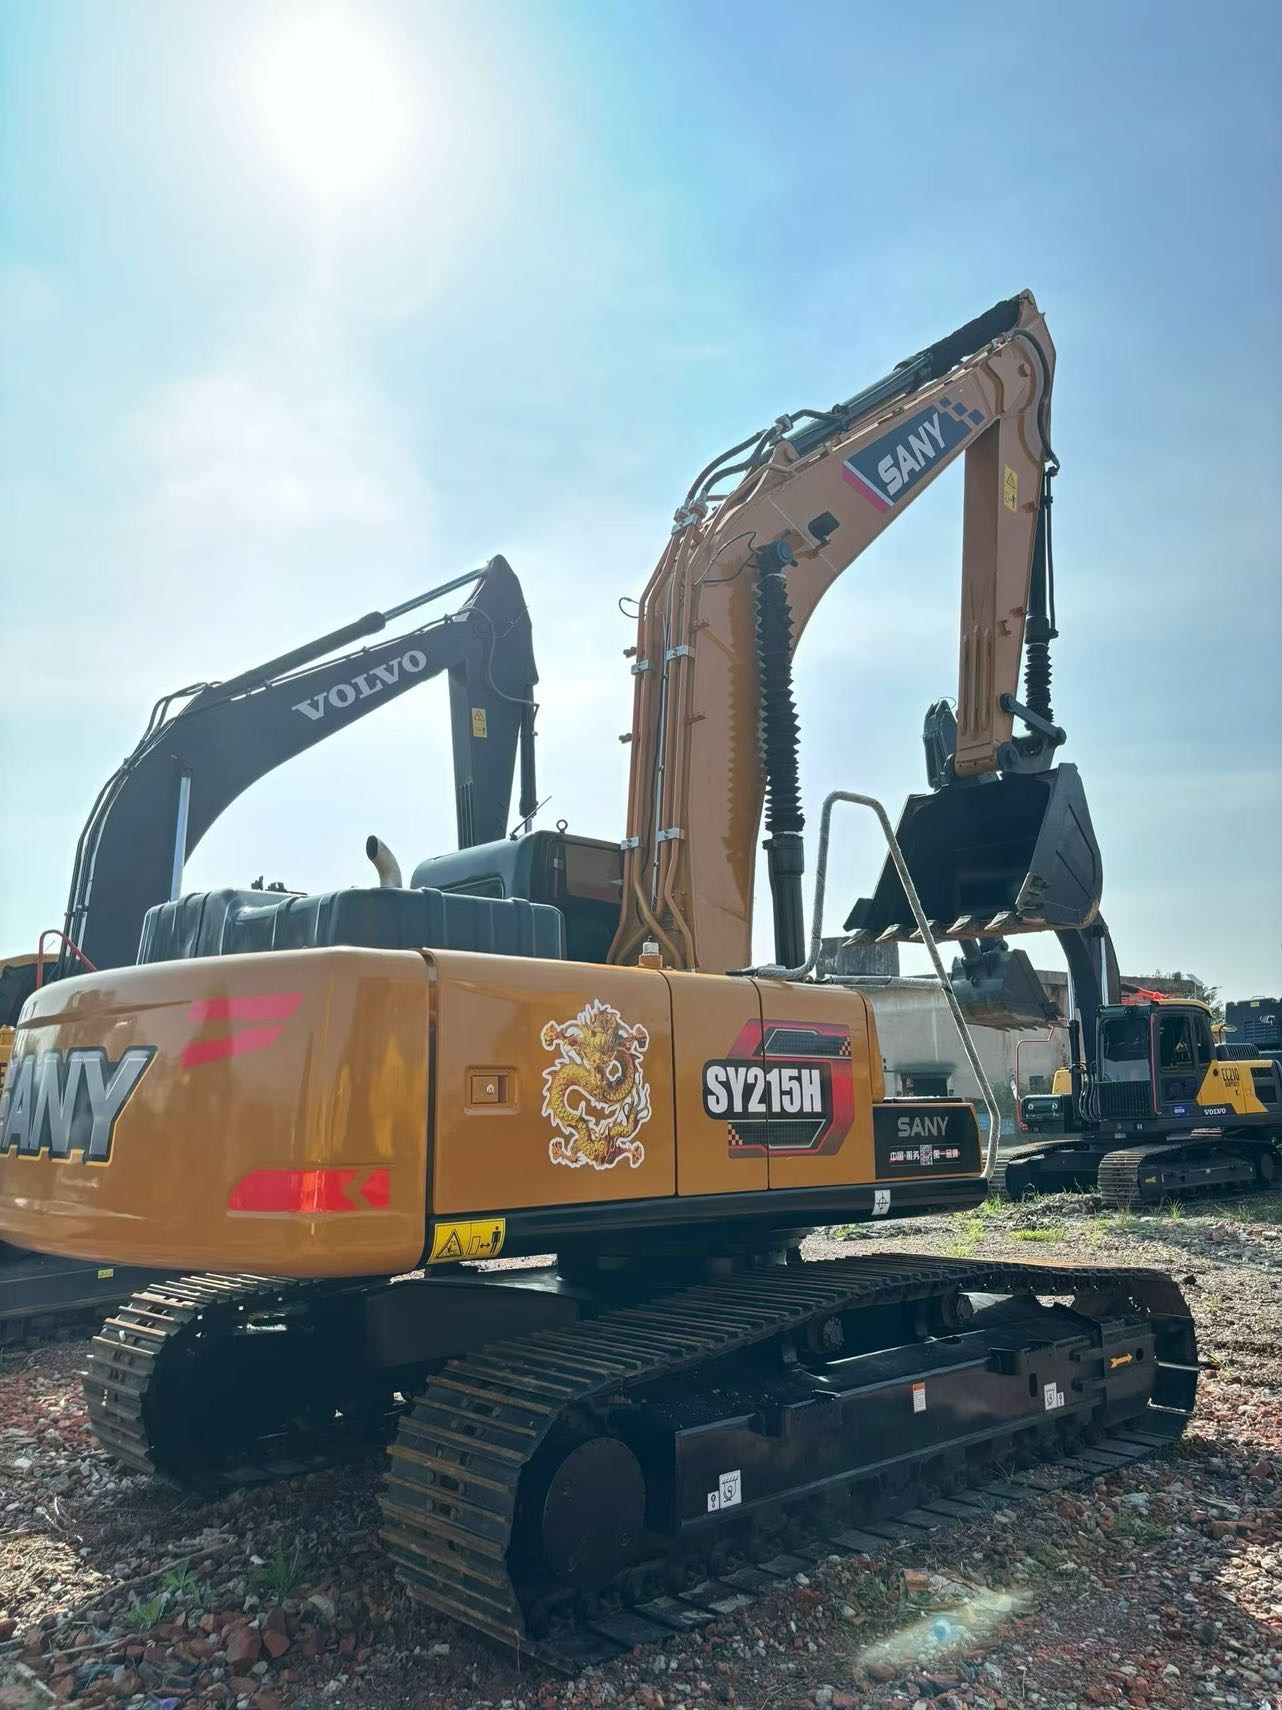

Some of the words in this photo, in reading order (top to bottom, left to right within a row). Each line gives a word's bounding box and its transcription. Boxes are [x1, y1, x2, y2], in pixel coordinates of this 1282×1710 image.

[877, 412, 946, 497] SANY
[291, 649, 427, 721] VOLVO
[706, 1065, 822, 1114] SY215H
[1203, 1107, 1227, 1116] VOLVO
[897, 1116, 950, 1137] SANY
